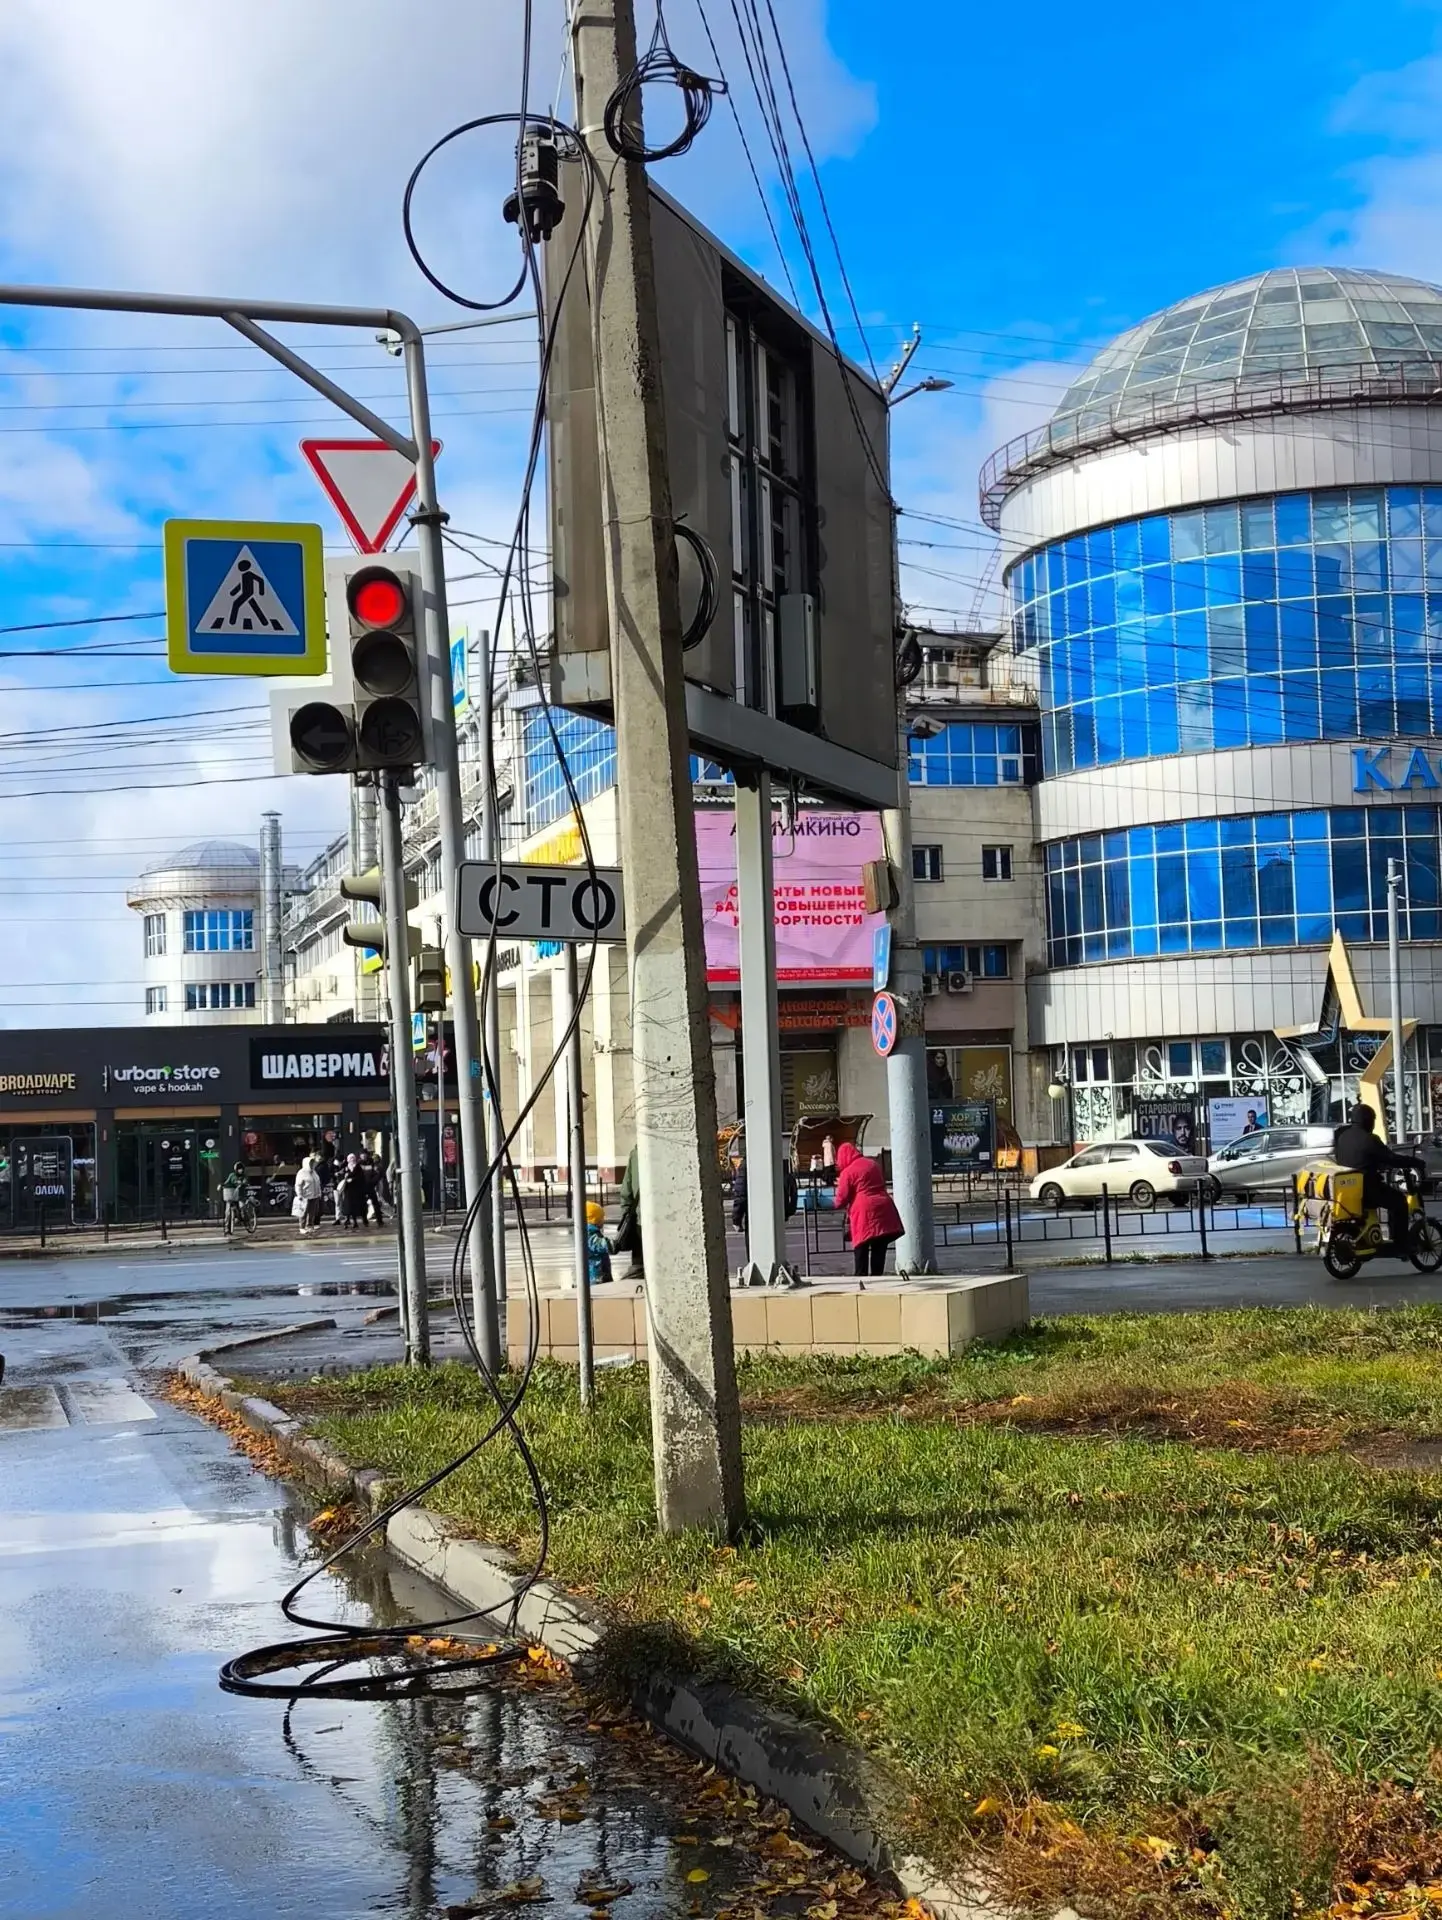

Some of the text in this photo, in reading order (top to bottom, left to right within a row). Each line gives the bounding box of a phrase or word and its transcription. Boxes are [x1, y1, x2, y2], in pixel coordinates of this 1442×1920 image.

[1352, 747, 1442, 792] КА
[811, 886, 865, 896] НОВЫЕ
[479, 873, 626, 931] СТО
[775, 901, 867, 911] ОВЫШЕННО
[262, 1053, 376, 1079] ШАВЕРМА
[114, 1065, 221, 1081] urban store
[0, 1073, 76, 1092] BROADVAPE
[133, 1083, 203, 1094] vape & hookah
[932, 1109, 943, 1117] 22
[1139, 1102, 1192, 1114] СТАРОВОЙТОВ
[951, 1113, 970, 1122] ХОР
